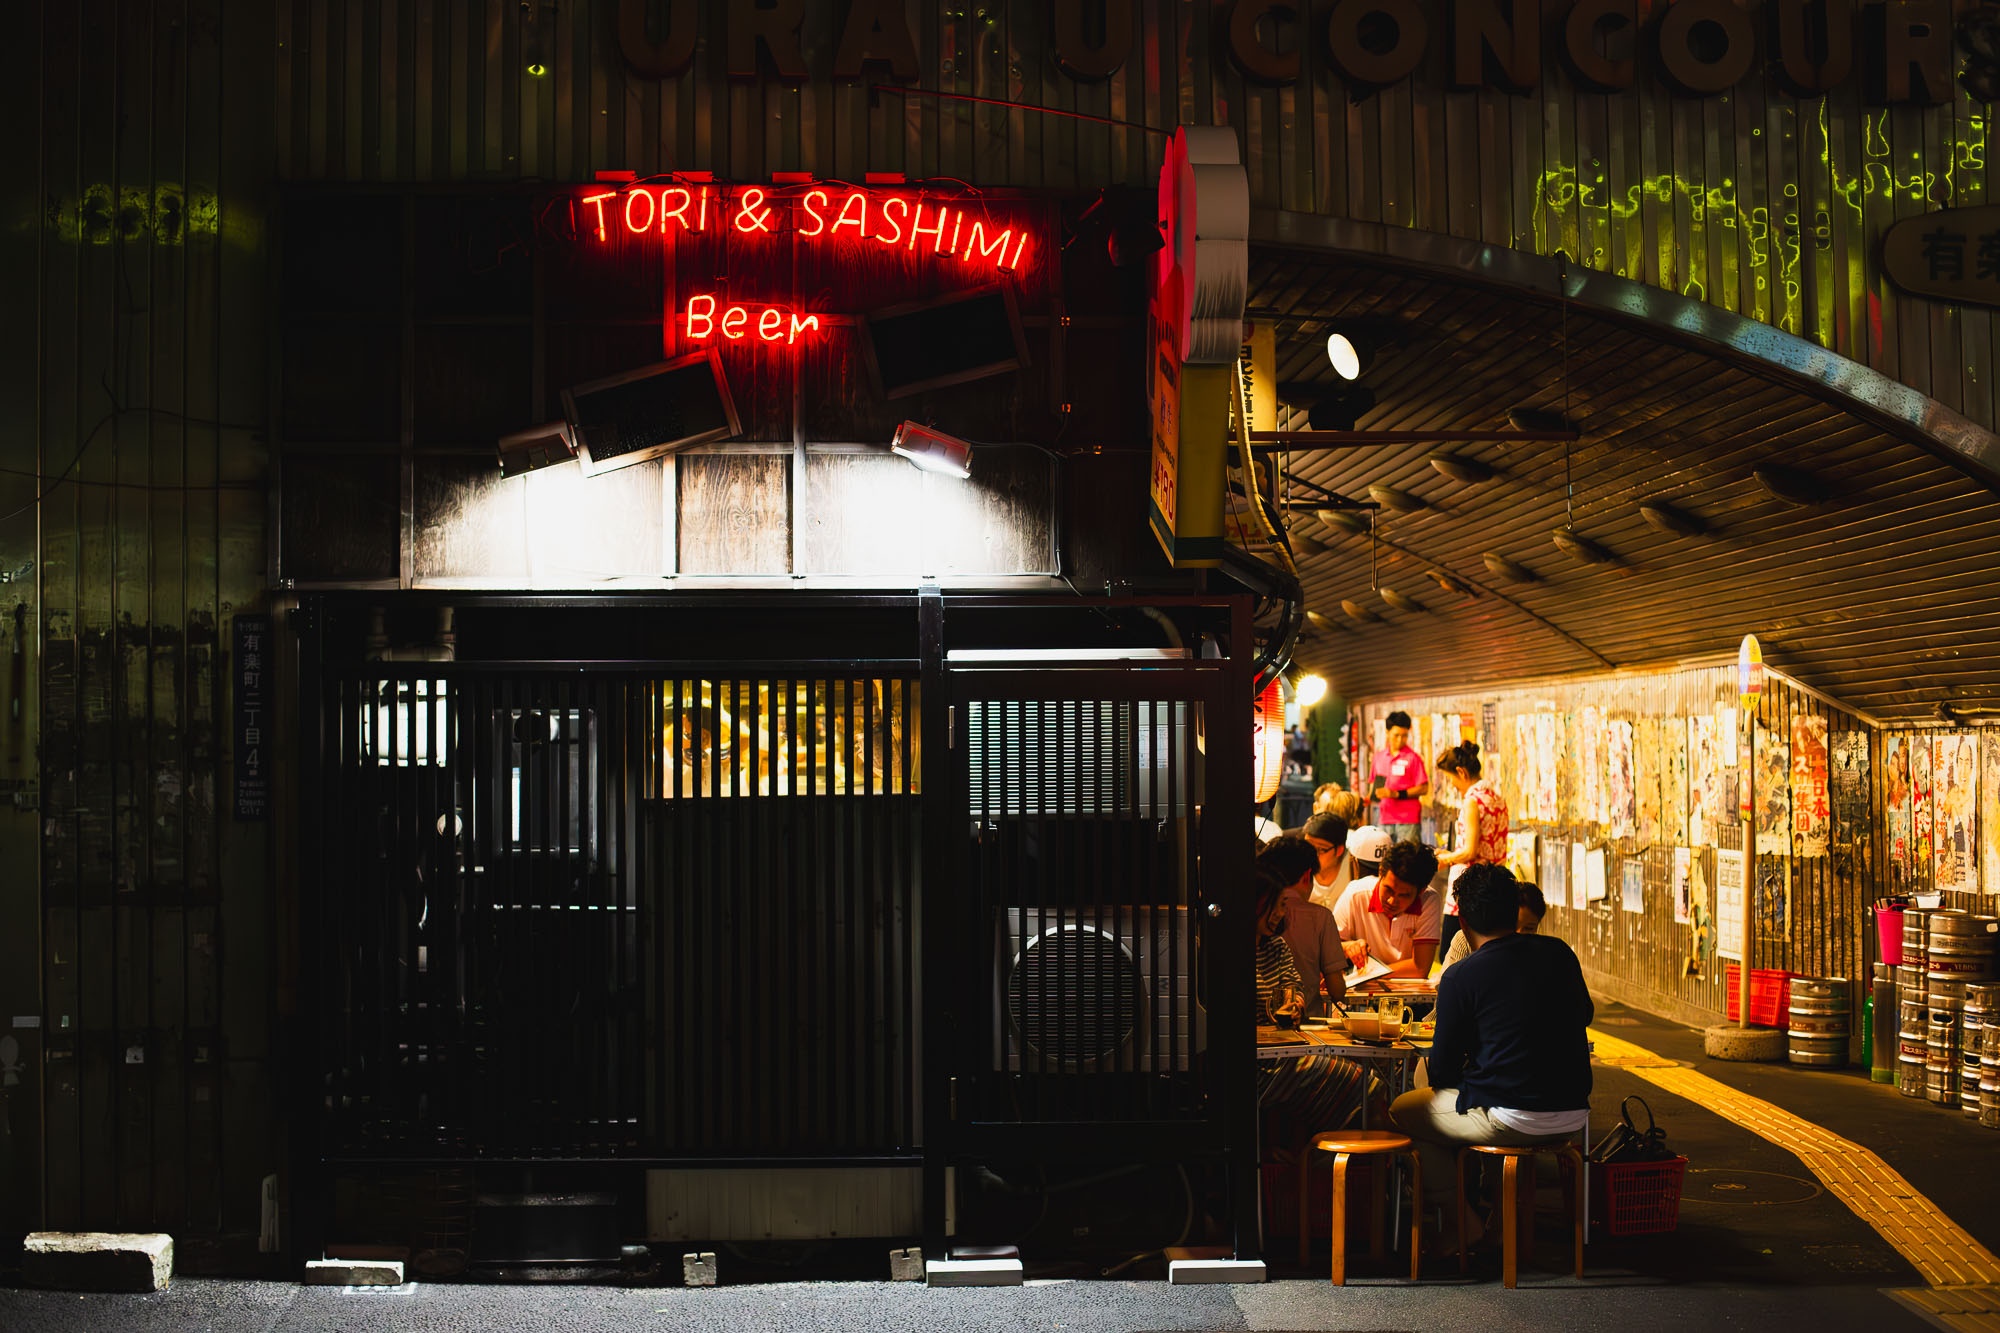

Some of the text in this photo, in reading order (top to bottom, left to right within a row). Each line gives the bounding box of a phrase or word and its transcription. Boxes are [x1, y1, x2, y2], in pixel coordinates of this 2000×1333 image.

[582, 186, 1028, 270] TORI & SASHIMI
[686, 294, 819, 345] Beer
